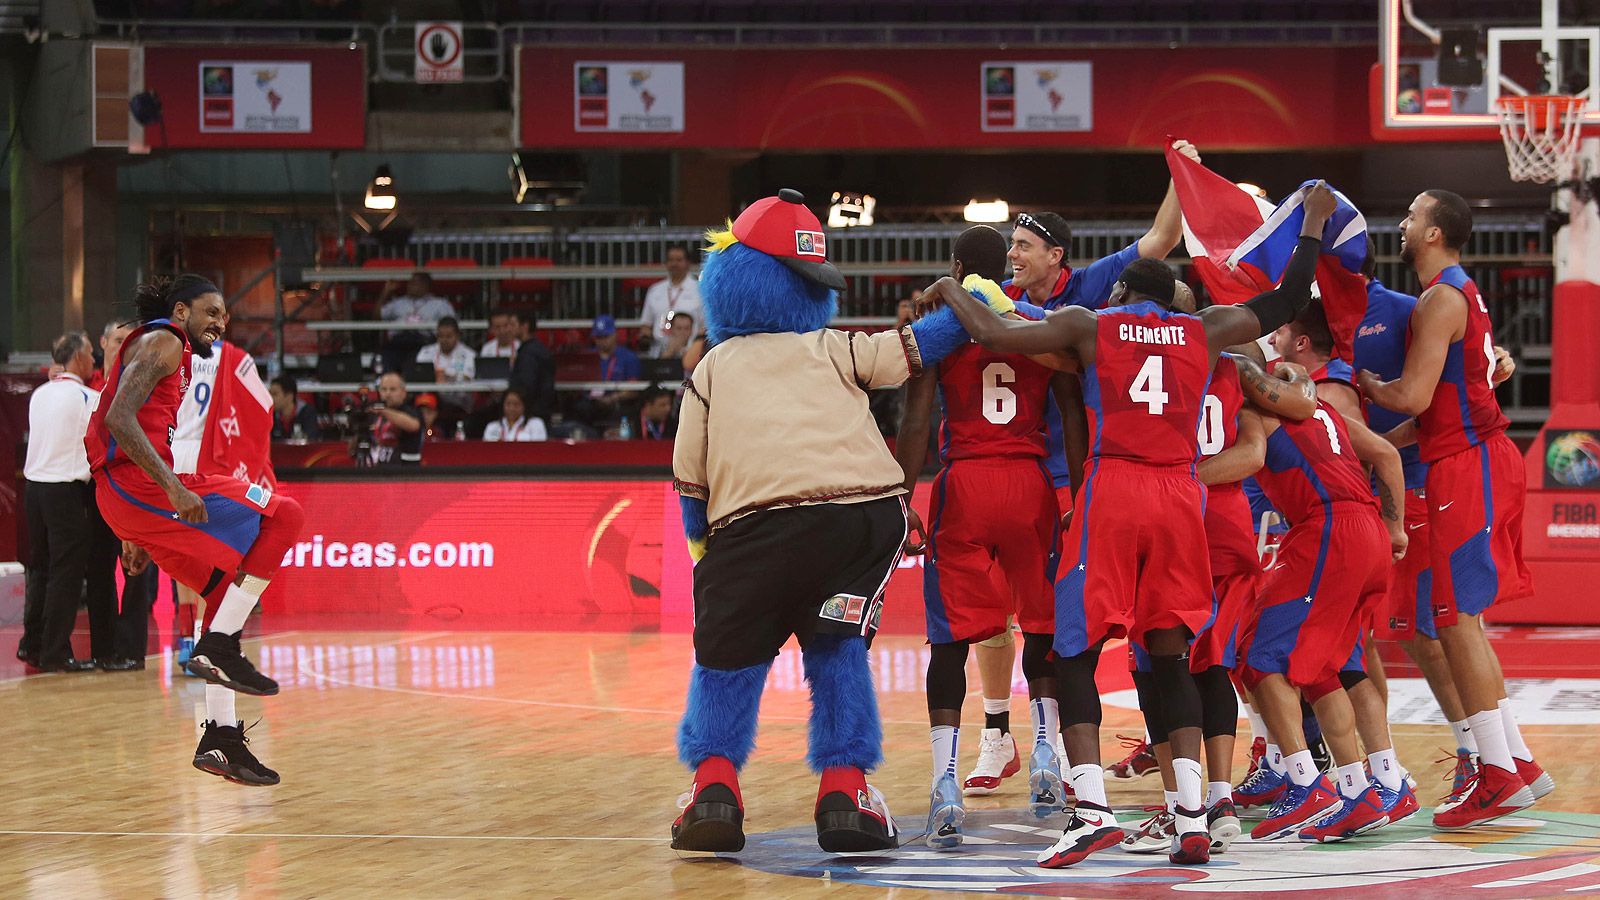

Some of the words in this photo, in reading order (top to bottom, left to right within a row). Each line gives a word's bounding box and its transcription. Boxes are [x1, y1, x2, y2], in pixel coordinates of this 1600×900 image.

[1119, 324, 1186, 345] CLEMENTE
[195, 382, 210, 416] 9
[982, 362, 1017, 424] 6
[1128, 355, 1168, 414] 4
[1552, 503, 1596, 524] FIBA
[280, 534, 494, 568] ricas.com
